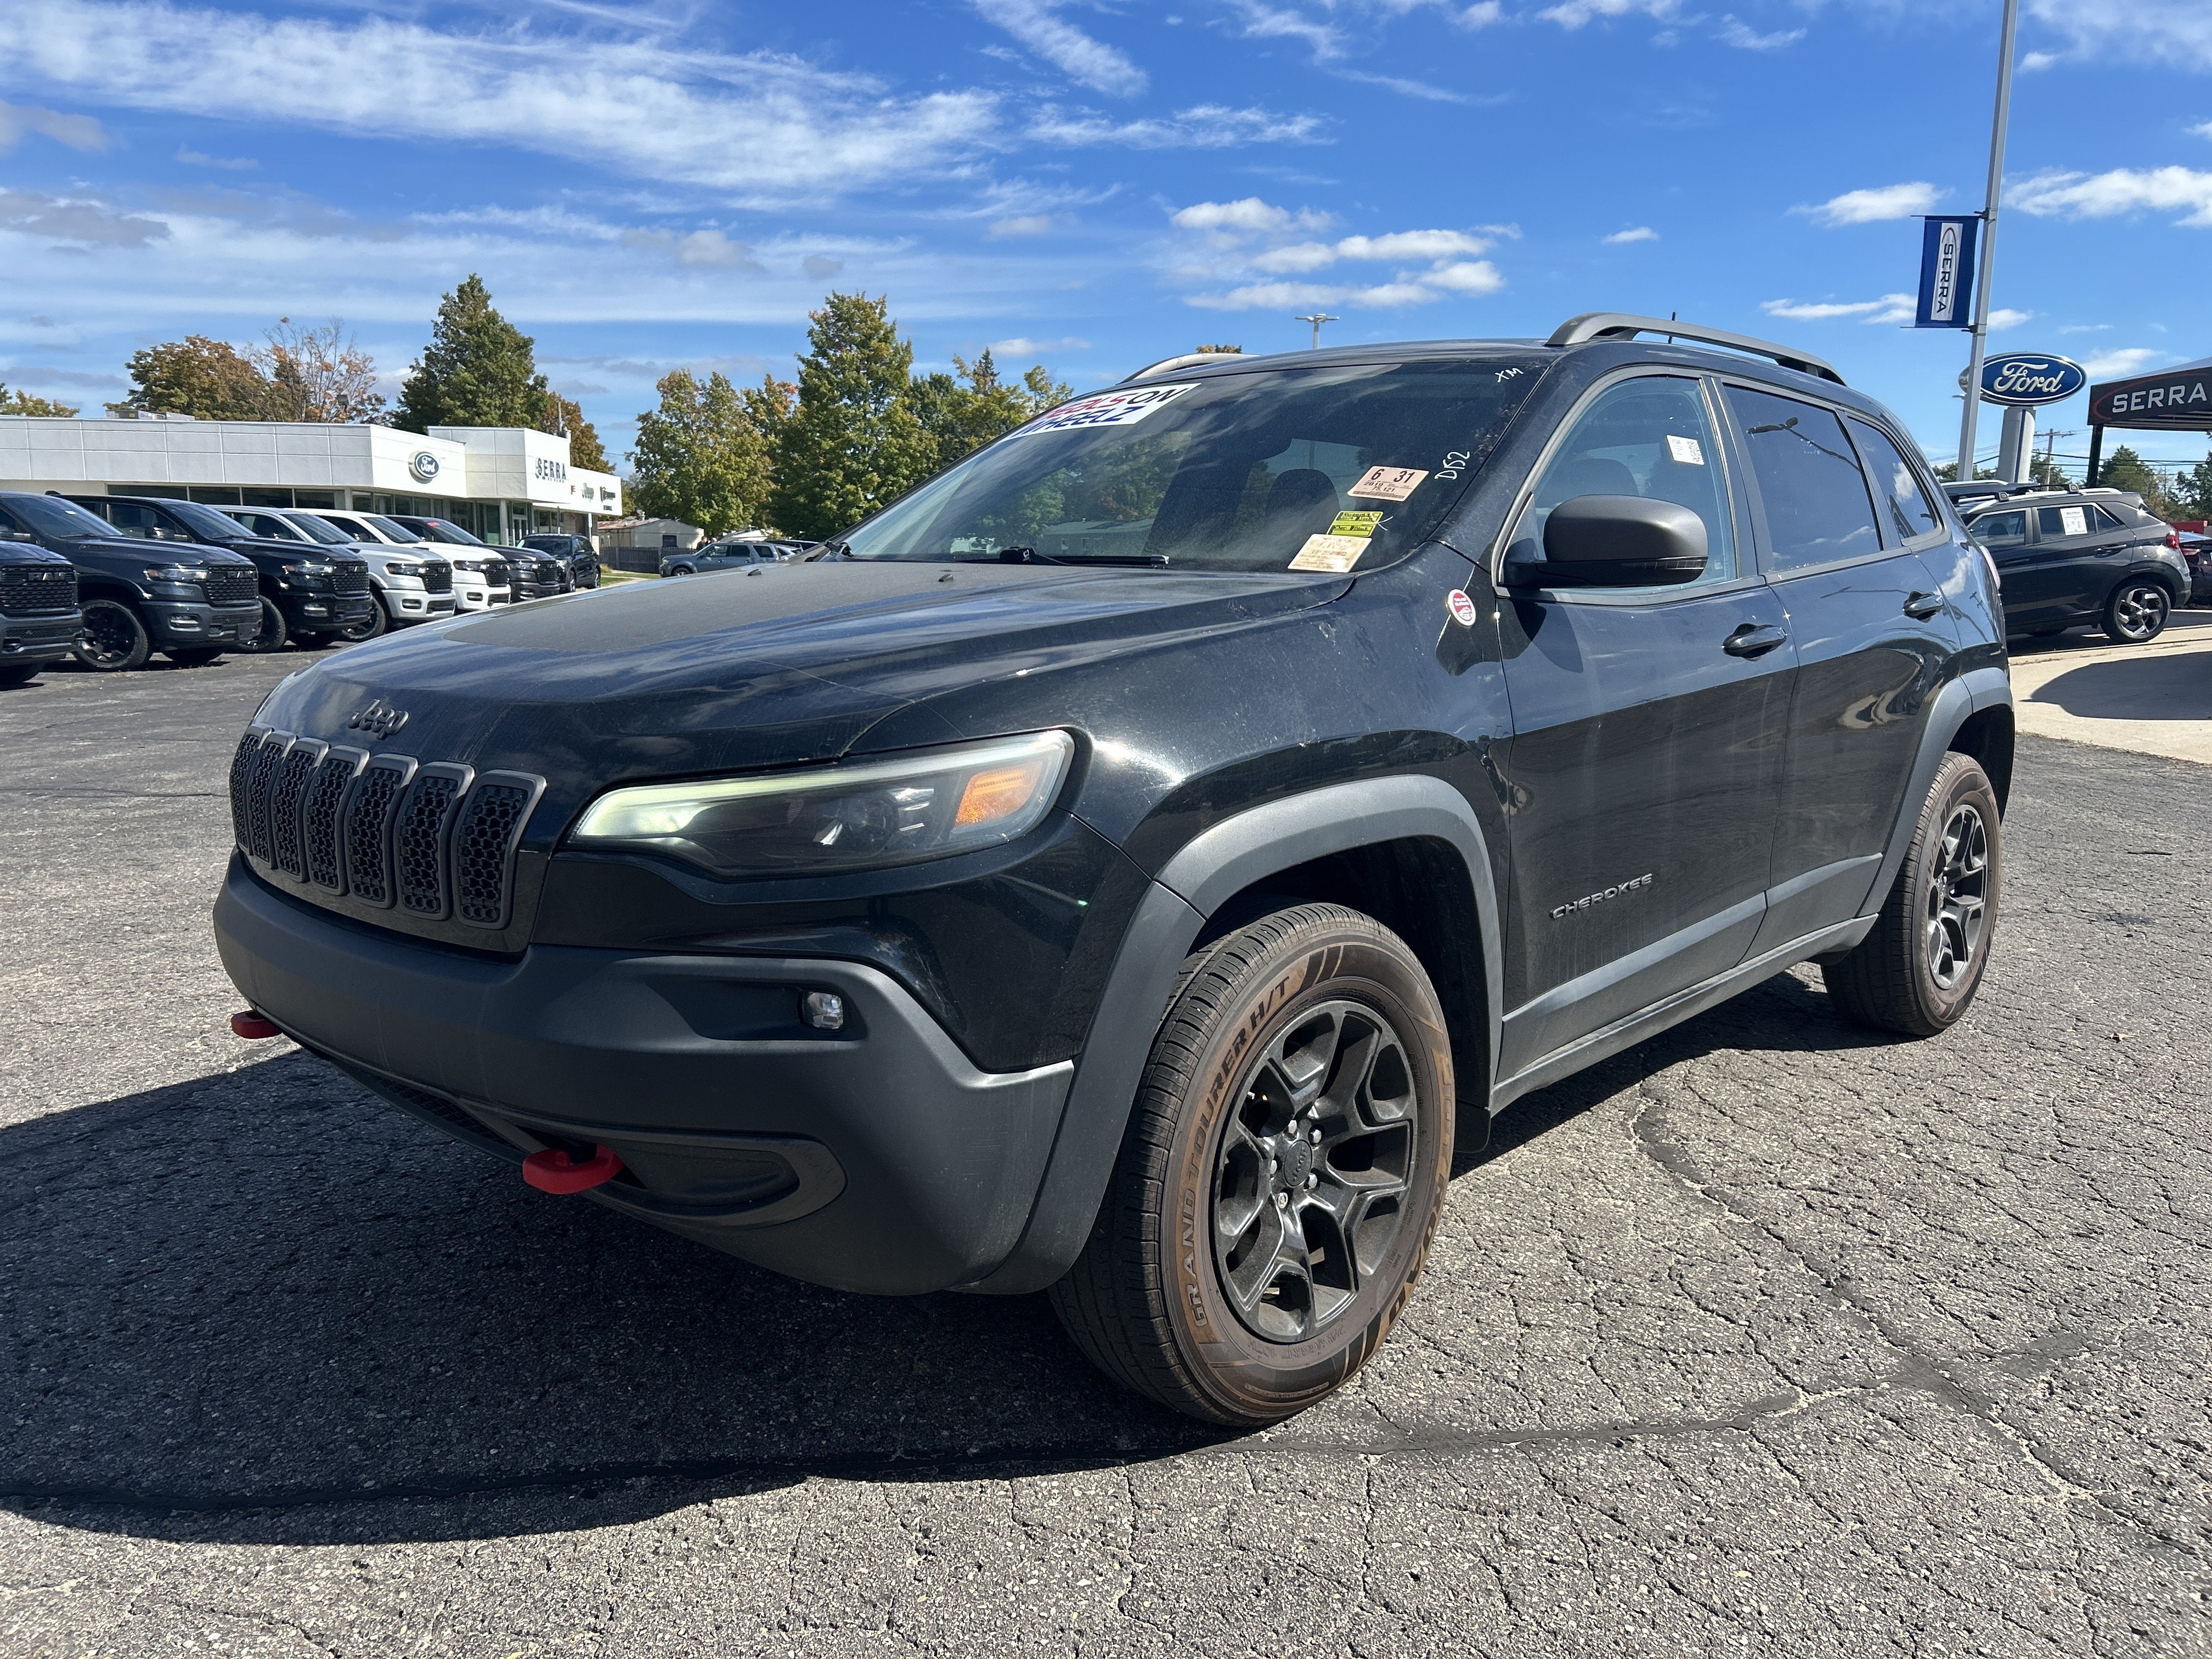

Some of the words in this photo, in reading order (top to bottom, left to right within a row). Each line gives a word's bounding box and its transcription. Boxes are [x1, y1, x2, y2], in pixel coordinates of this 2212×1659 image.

[1935, 242, 1954, 314] SERRA
[1495, 368, 1524, 383] XM
[1993, 362, 2066, 393] Ford
[1127, 388, 1188, 404] ON
[2112, 382, 2208, 413] SERRA
[1011, 405, 1147, 438] WHEELZ
[421, 456, 436, 473] Ford
[537, 458, 567, 480] SERRA
[1371, 469, 1385, 481] 6
[1393, 470, 1415, 483] 31
[347, 699, 410, 740] Jeep
[1550, 873, 1653, 919] CHEROKEE
[1249, 976, 1290, 1031] H/T
[1188, 1028, 1248, 1180] TOURER
[1182, 1188, 1207, 1327] GRAND
